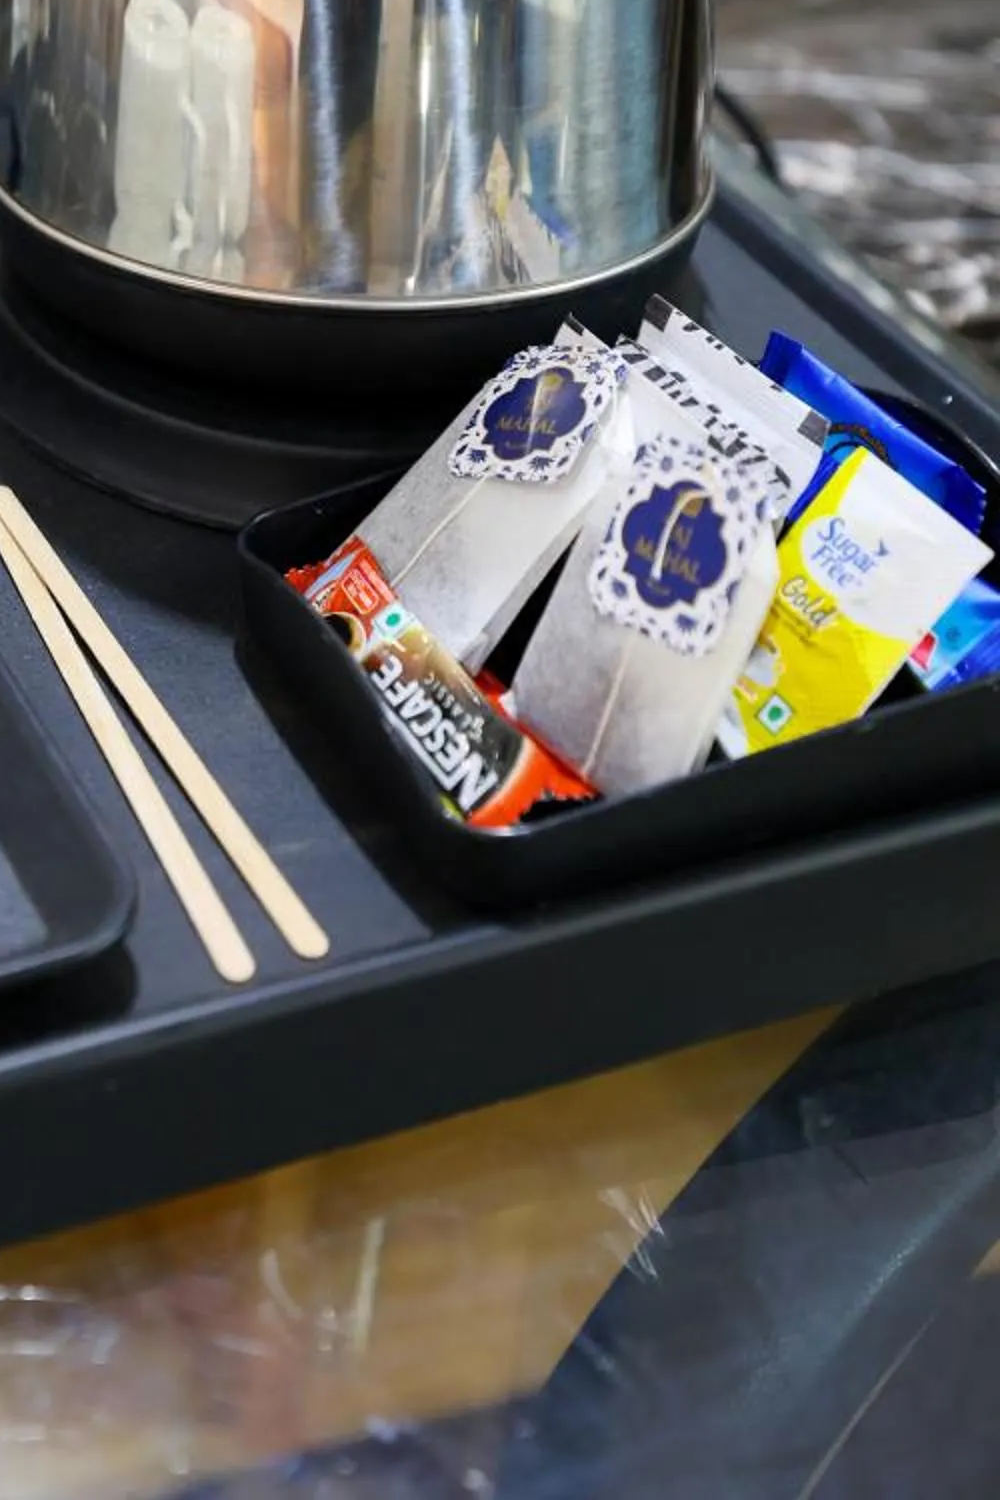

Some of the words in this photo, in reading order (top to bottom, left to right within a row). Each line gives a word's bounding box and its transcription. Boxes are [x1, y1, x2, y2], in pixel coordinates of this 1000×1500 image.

[811, 544, 854, 588] Free
[817, 517, 878, 574] Sugar
[782, 575, 839, 630] Gold
